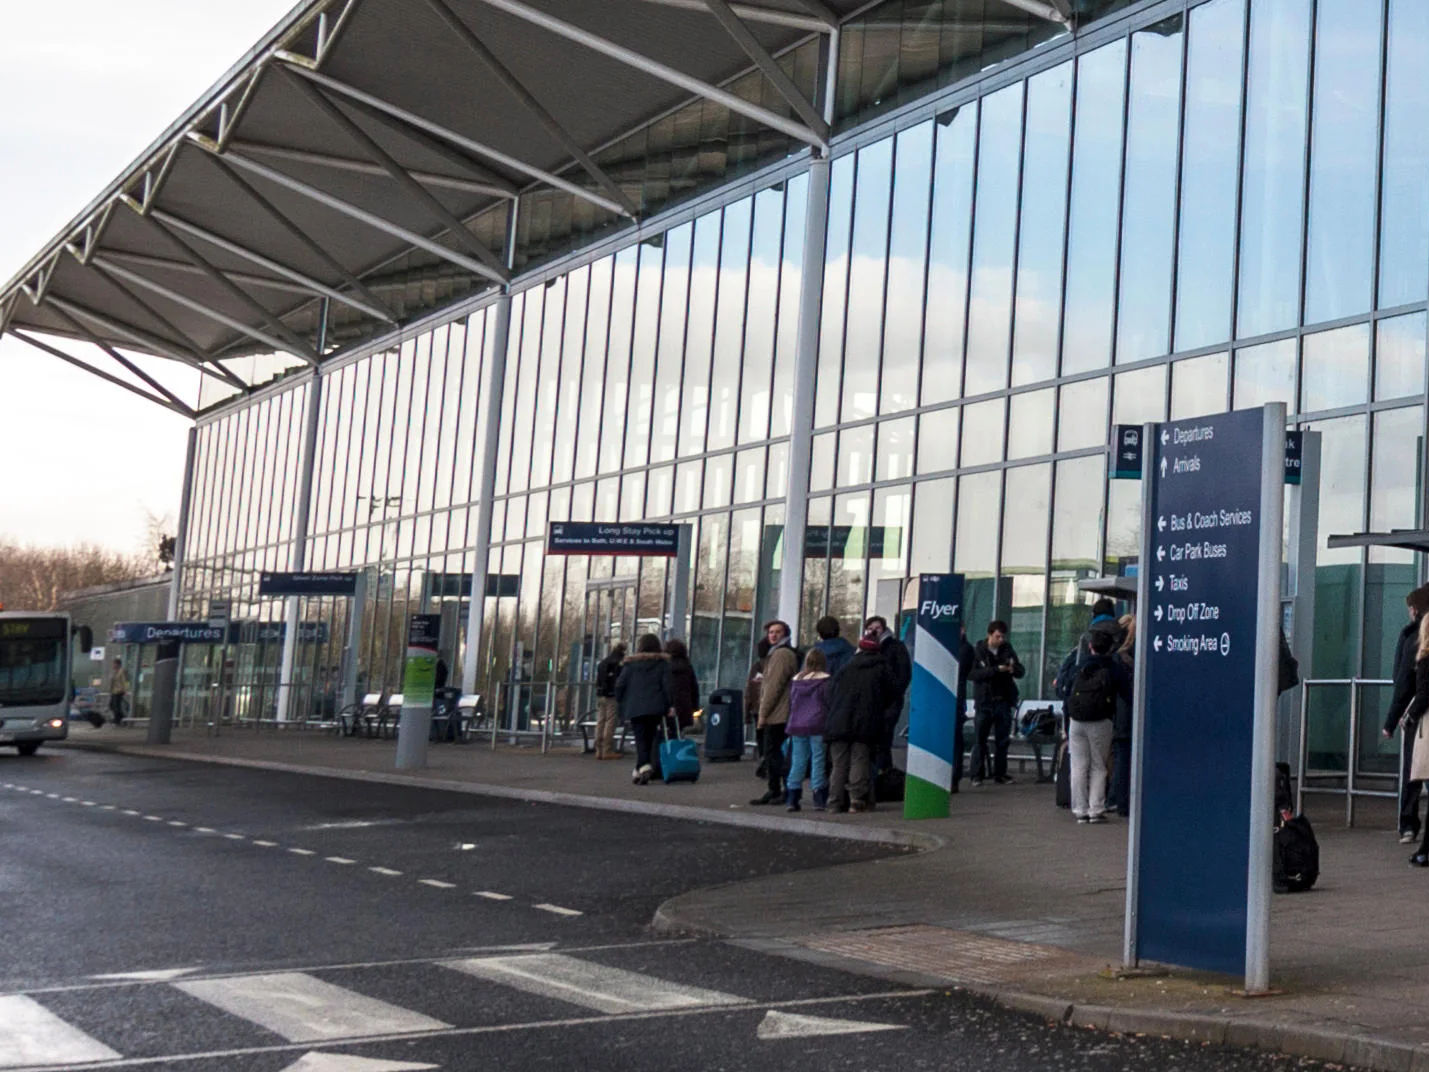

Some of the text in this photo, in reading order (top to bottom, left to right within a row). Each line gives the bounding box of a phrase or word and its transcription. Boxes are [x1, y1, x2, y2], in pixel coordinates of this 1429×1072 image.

[1173, 426, 1214, 446] Departures
[1173, 456, 1201, 474] Arrivals
[1171, 509, 1252, 531] Bus & Coach Services
[1170, 541, 1227, 561] Car Park Buses
[1169, 574, 1189, 591] Taxis
[920, 600, 958, 620] Flyer
[1168, 602, 1219, 624] Drop Off Zone
[146, 627, 221, 641] Departures
[1167, 634, 1217, 656] Smoking Area
